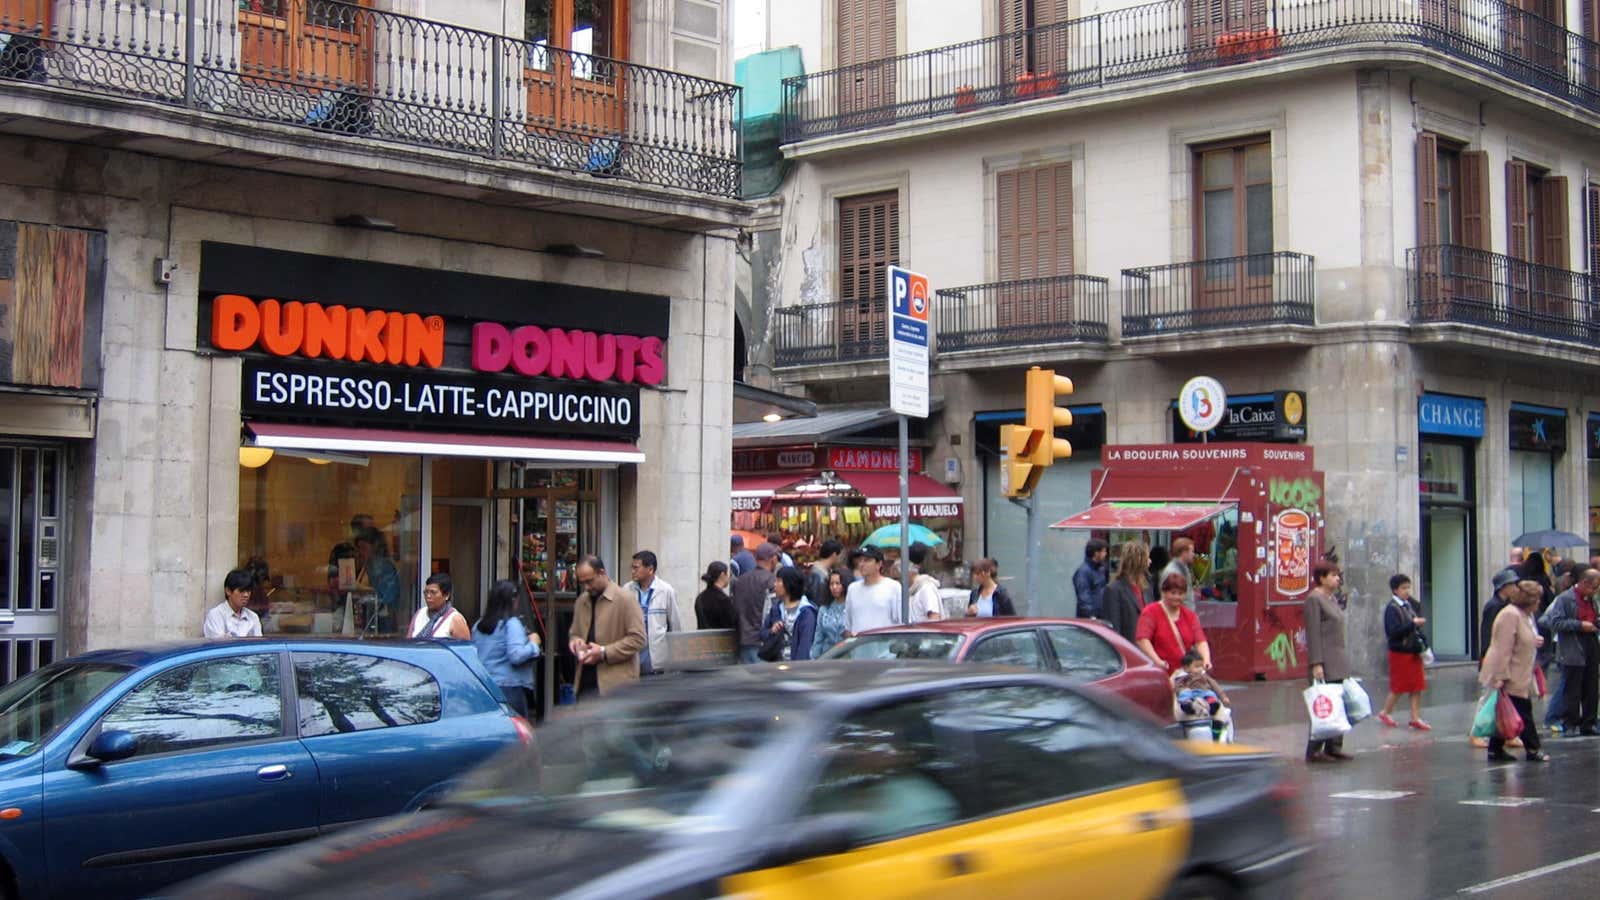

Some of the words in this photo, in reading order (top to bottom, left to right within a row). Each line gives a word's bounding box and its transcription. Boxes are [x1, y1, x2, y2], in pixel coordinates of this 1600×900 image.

[895, 277, 907, 307] P
[471, 321, 667, 386] DONUTS
[255, 370, 633, 426] ESPRESSO-LATTE-CAPPUCCINO
[1420, 402, 1483, 428] CHANGE
[1108, 450, 1121, 460] LA
[1124, 449, 1180, 460] BOQUERIA
[1182, 448, 1247, 460] SOUVENIRS
[1263, 450, 1306, 461] SOUVENIRS
[919, 504, 958, 517] GUIJUELO
